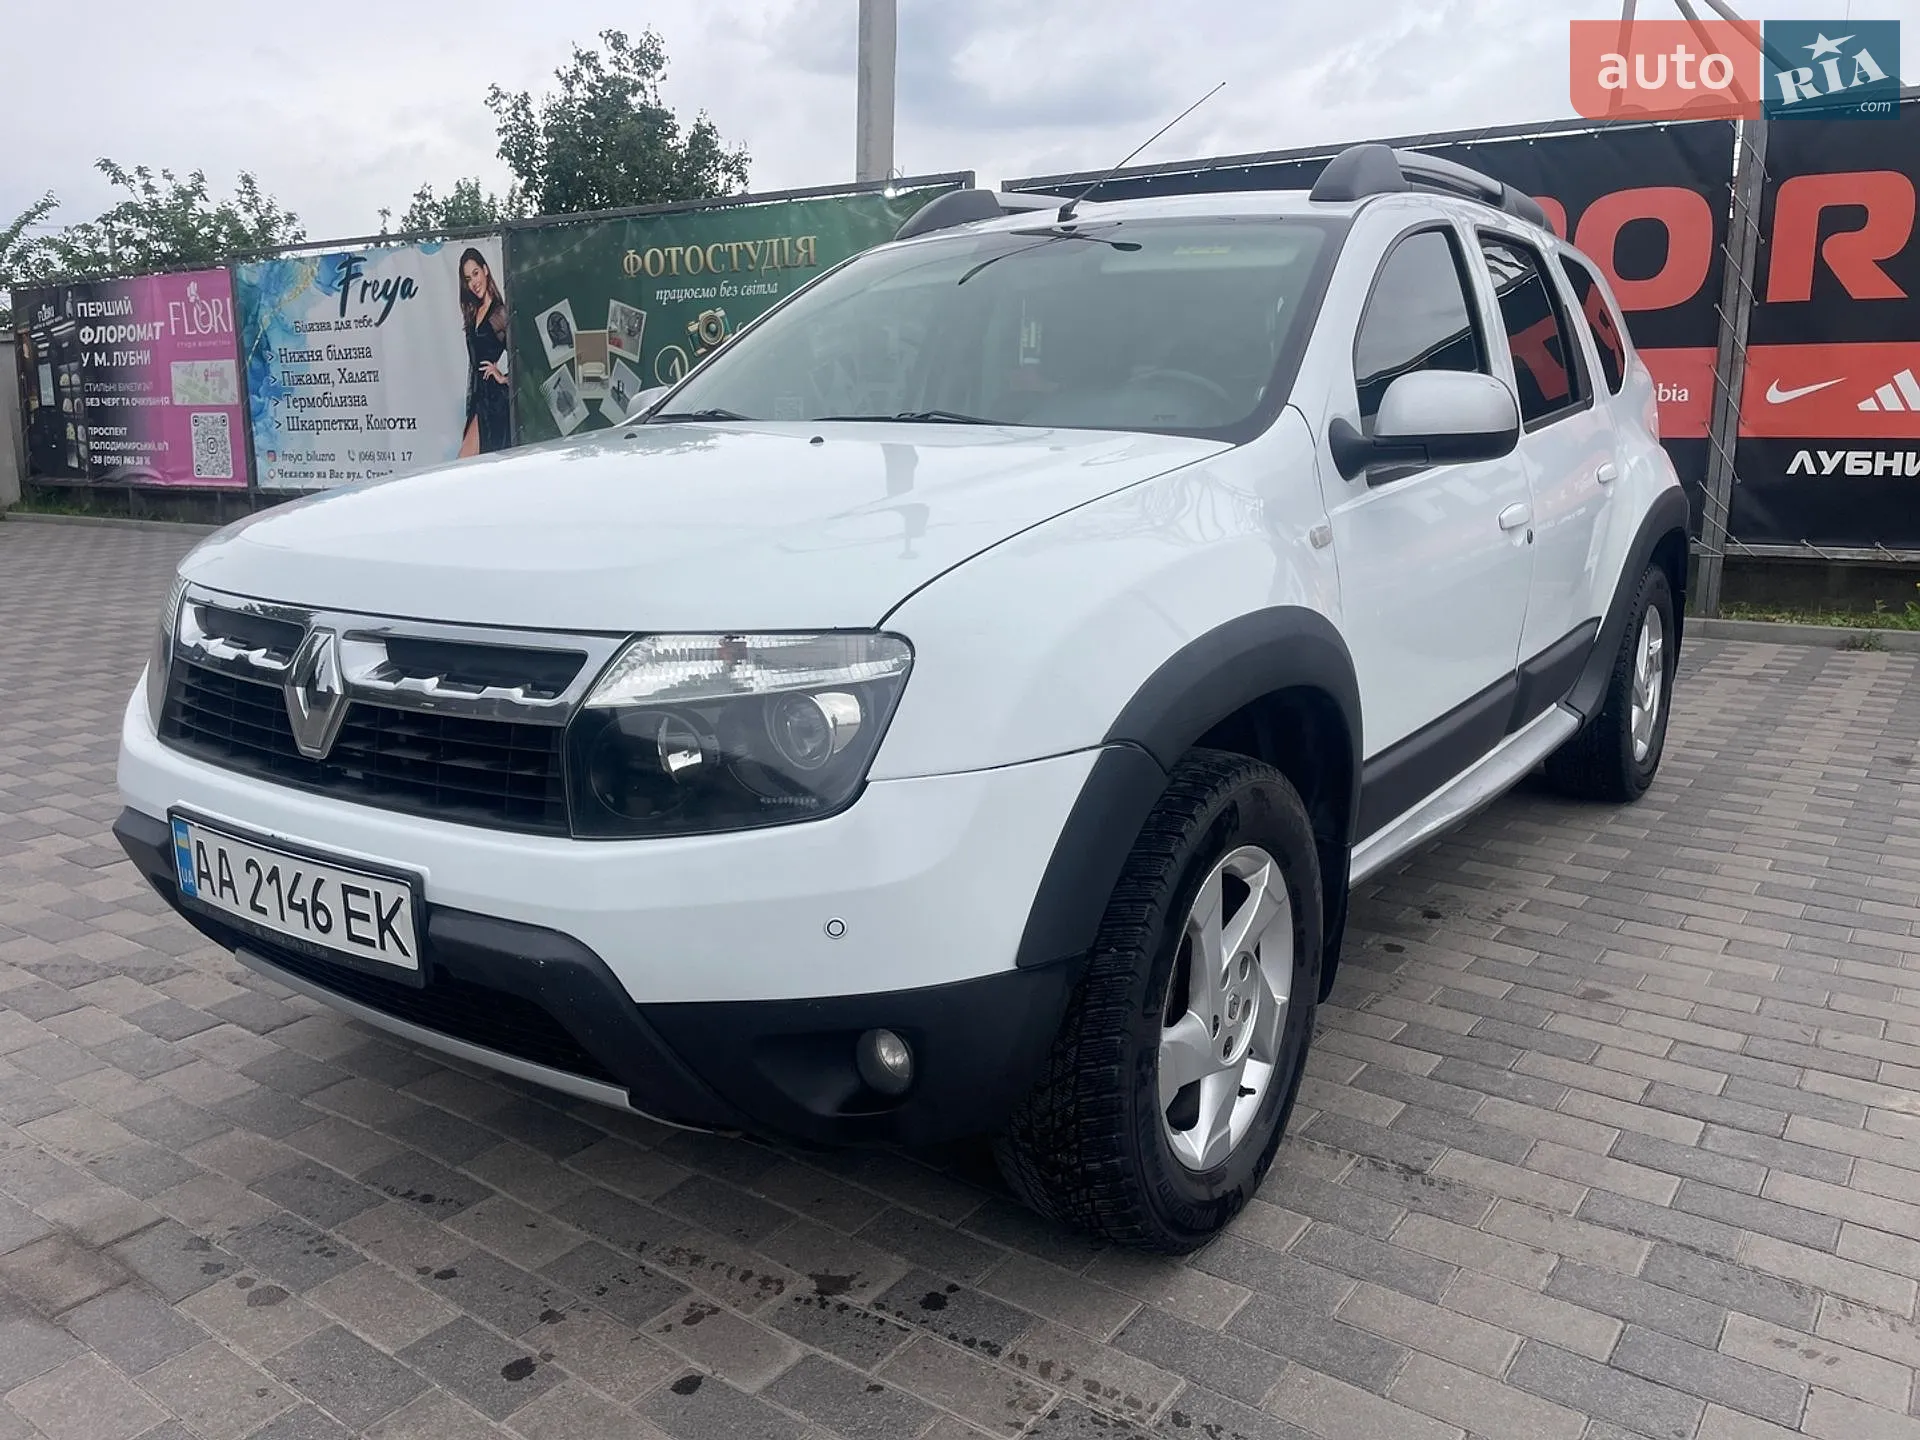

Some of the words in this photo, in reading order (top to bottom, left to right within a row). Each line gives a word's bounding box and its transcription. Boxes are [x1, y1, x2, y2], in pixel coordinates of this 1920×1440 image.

[1531, 170, 1916, 313] OR
[622, 236, 817, 278] ФОТОСТУДІЯ
[337, 254, 419, 327] Freya
[655, 288, 717, 306] працюємо
[719, 280, 738, 298] без
[741, 279, 778, 296] світла
[77, 296, 134, 318] ПЕРШИЙ
[168, 297, 234, 336] FLORI
[79, 321, 165, 345] ФЛОРОМАТ
[81, 351, 90, 367] У
[94, 351, 111, 367] М.
[112, 350, 152, 367] ЛУБНИ
[278, 347, 324, 364] Нижня
[326, 344, 373, 361] білизна
[281, 370, 335, 388] Піжами,
[337, 367, 380, 384] Халати
[283, 391, 368, 412] Термобілизна
[87, 427, 128, 436] ПРОСПЕКТ
[286, 415, 362, 435] Шкарпетки,
[196, 839, 240, 905] AA
[245, 857, 333, 934] 2146
[341, 883, 411, 958] EK
